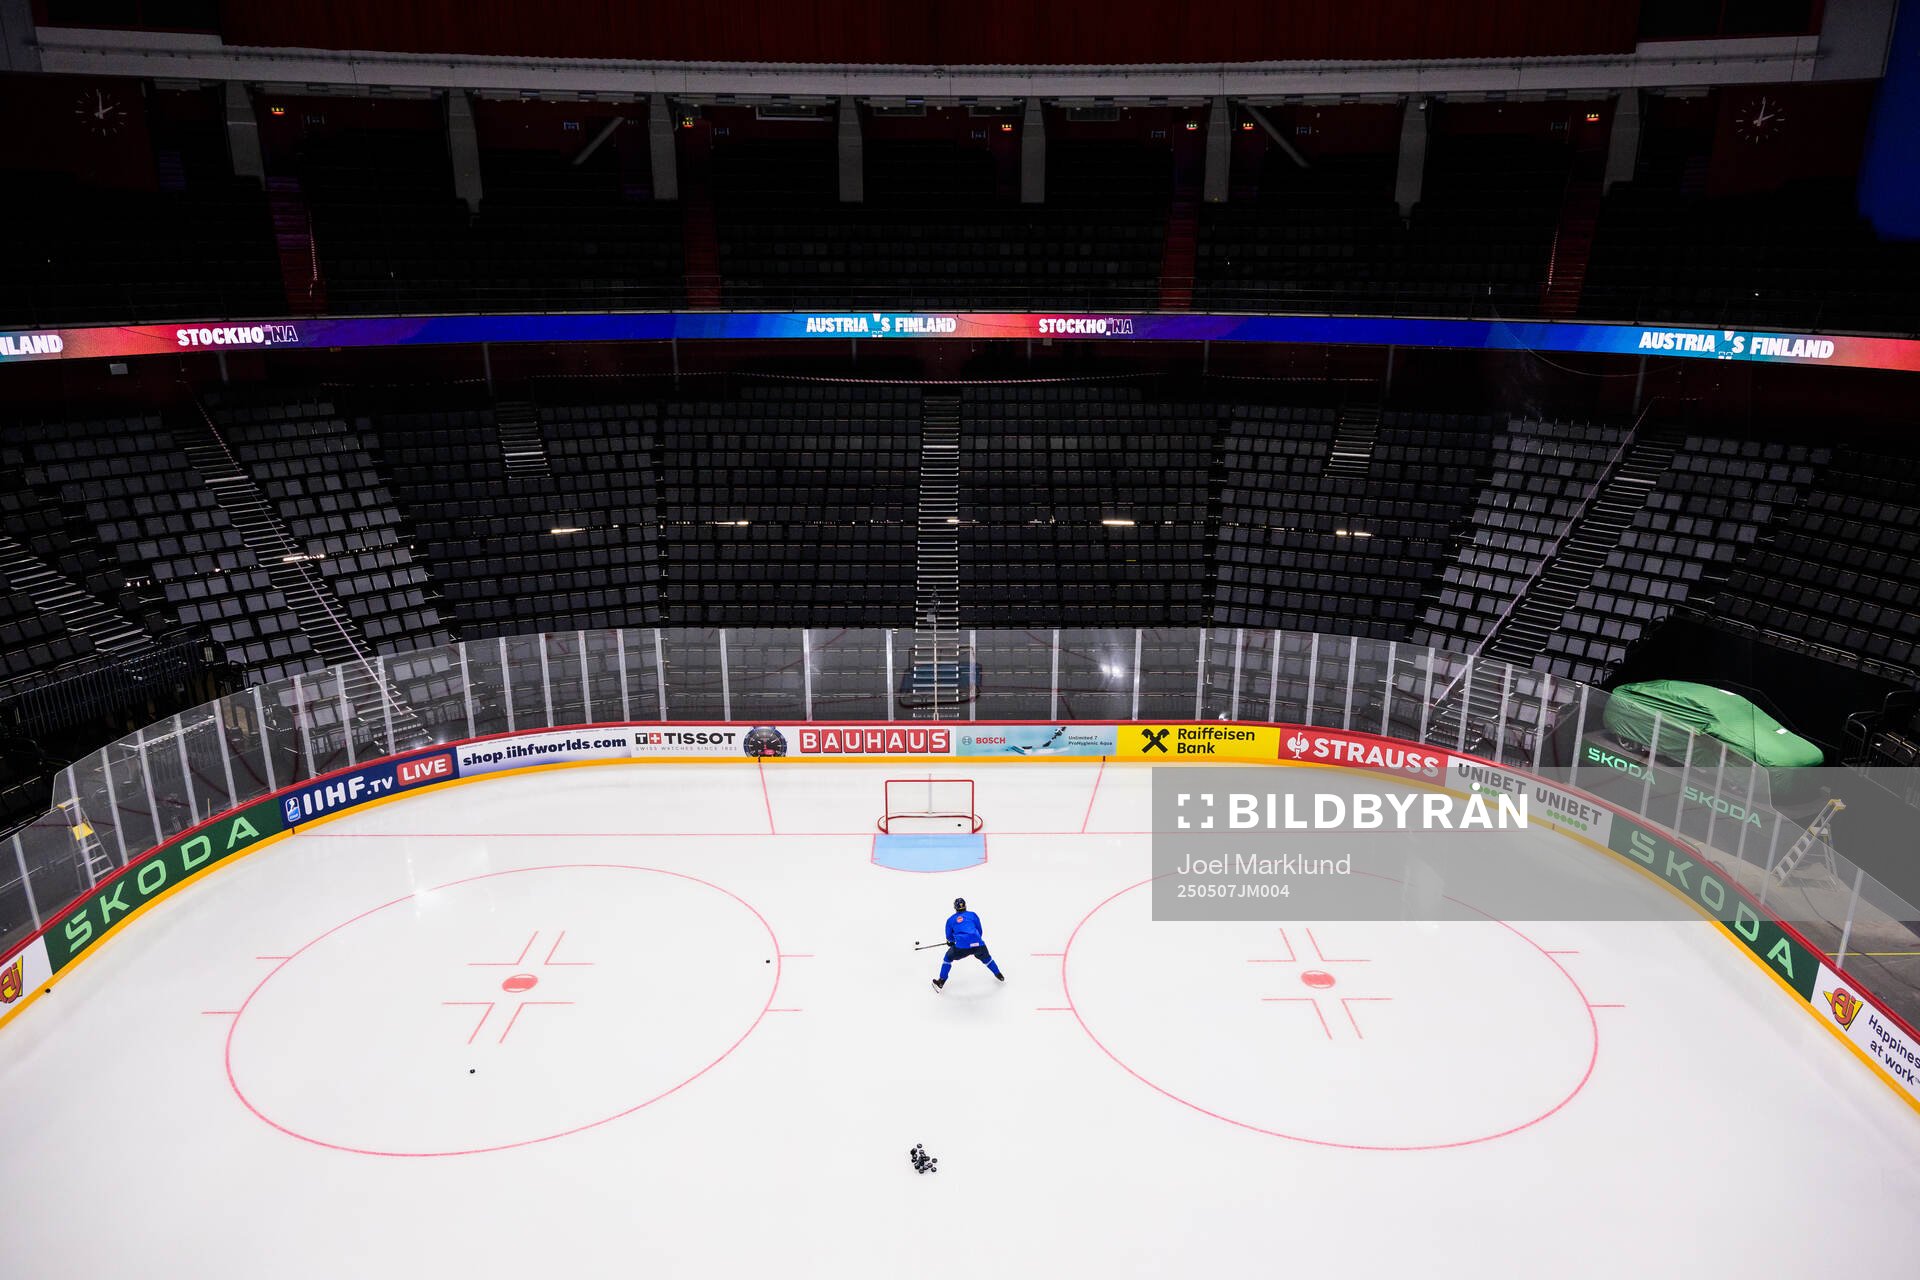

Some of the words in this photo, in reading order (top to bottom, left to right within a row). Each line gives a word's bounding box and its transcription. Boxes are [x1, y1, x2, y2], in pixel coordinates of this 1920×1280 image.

[806, 317, 868, 333] AUSTRIA
[895, 317, 956, 333] FINLAND
[1639, 332, 1716, 353] AUSTRIA
[1750, 337, 1834, 358] FINLAND
[664, 733, 736, 744] TISSOT
[802, 731, 948, 751] BAUHAUS
[1177, 727, 1256, 742] Raiffeisen
[463, 738, 627, 766] shop.iihfworlds.com
[1177, 742, 1216, 754] Bank
[1313, 738, 1440, 778] STRAUSS
[403, 758, 448, 781] LIVE
[1457, 763, 1527, 797] UNIBET
[1535, 786, 1603, 826] UNIBET
[1870, 1040, 1884, 1057] at
